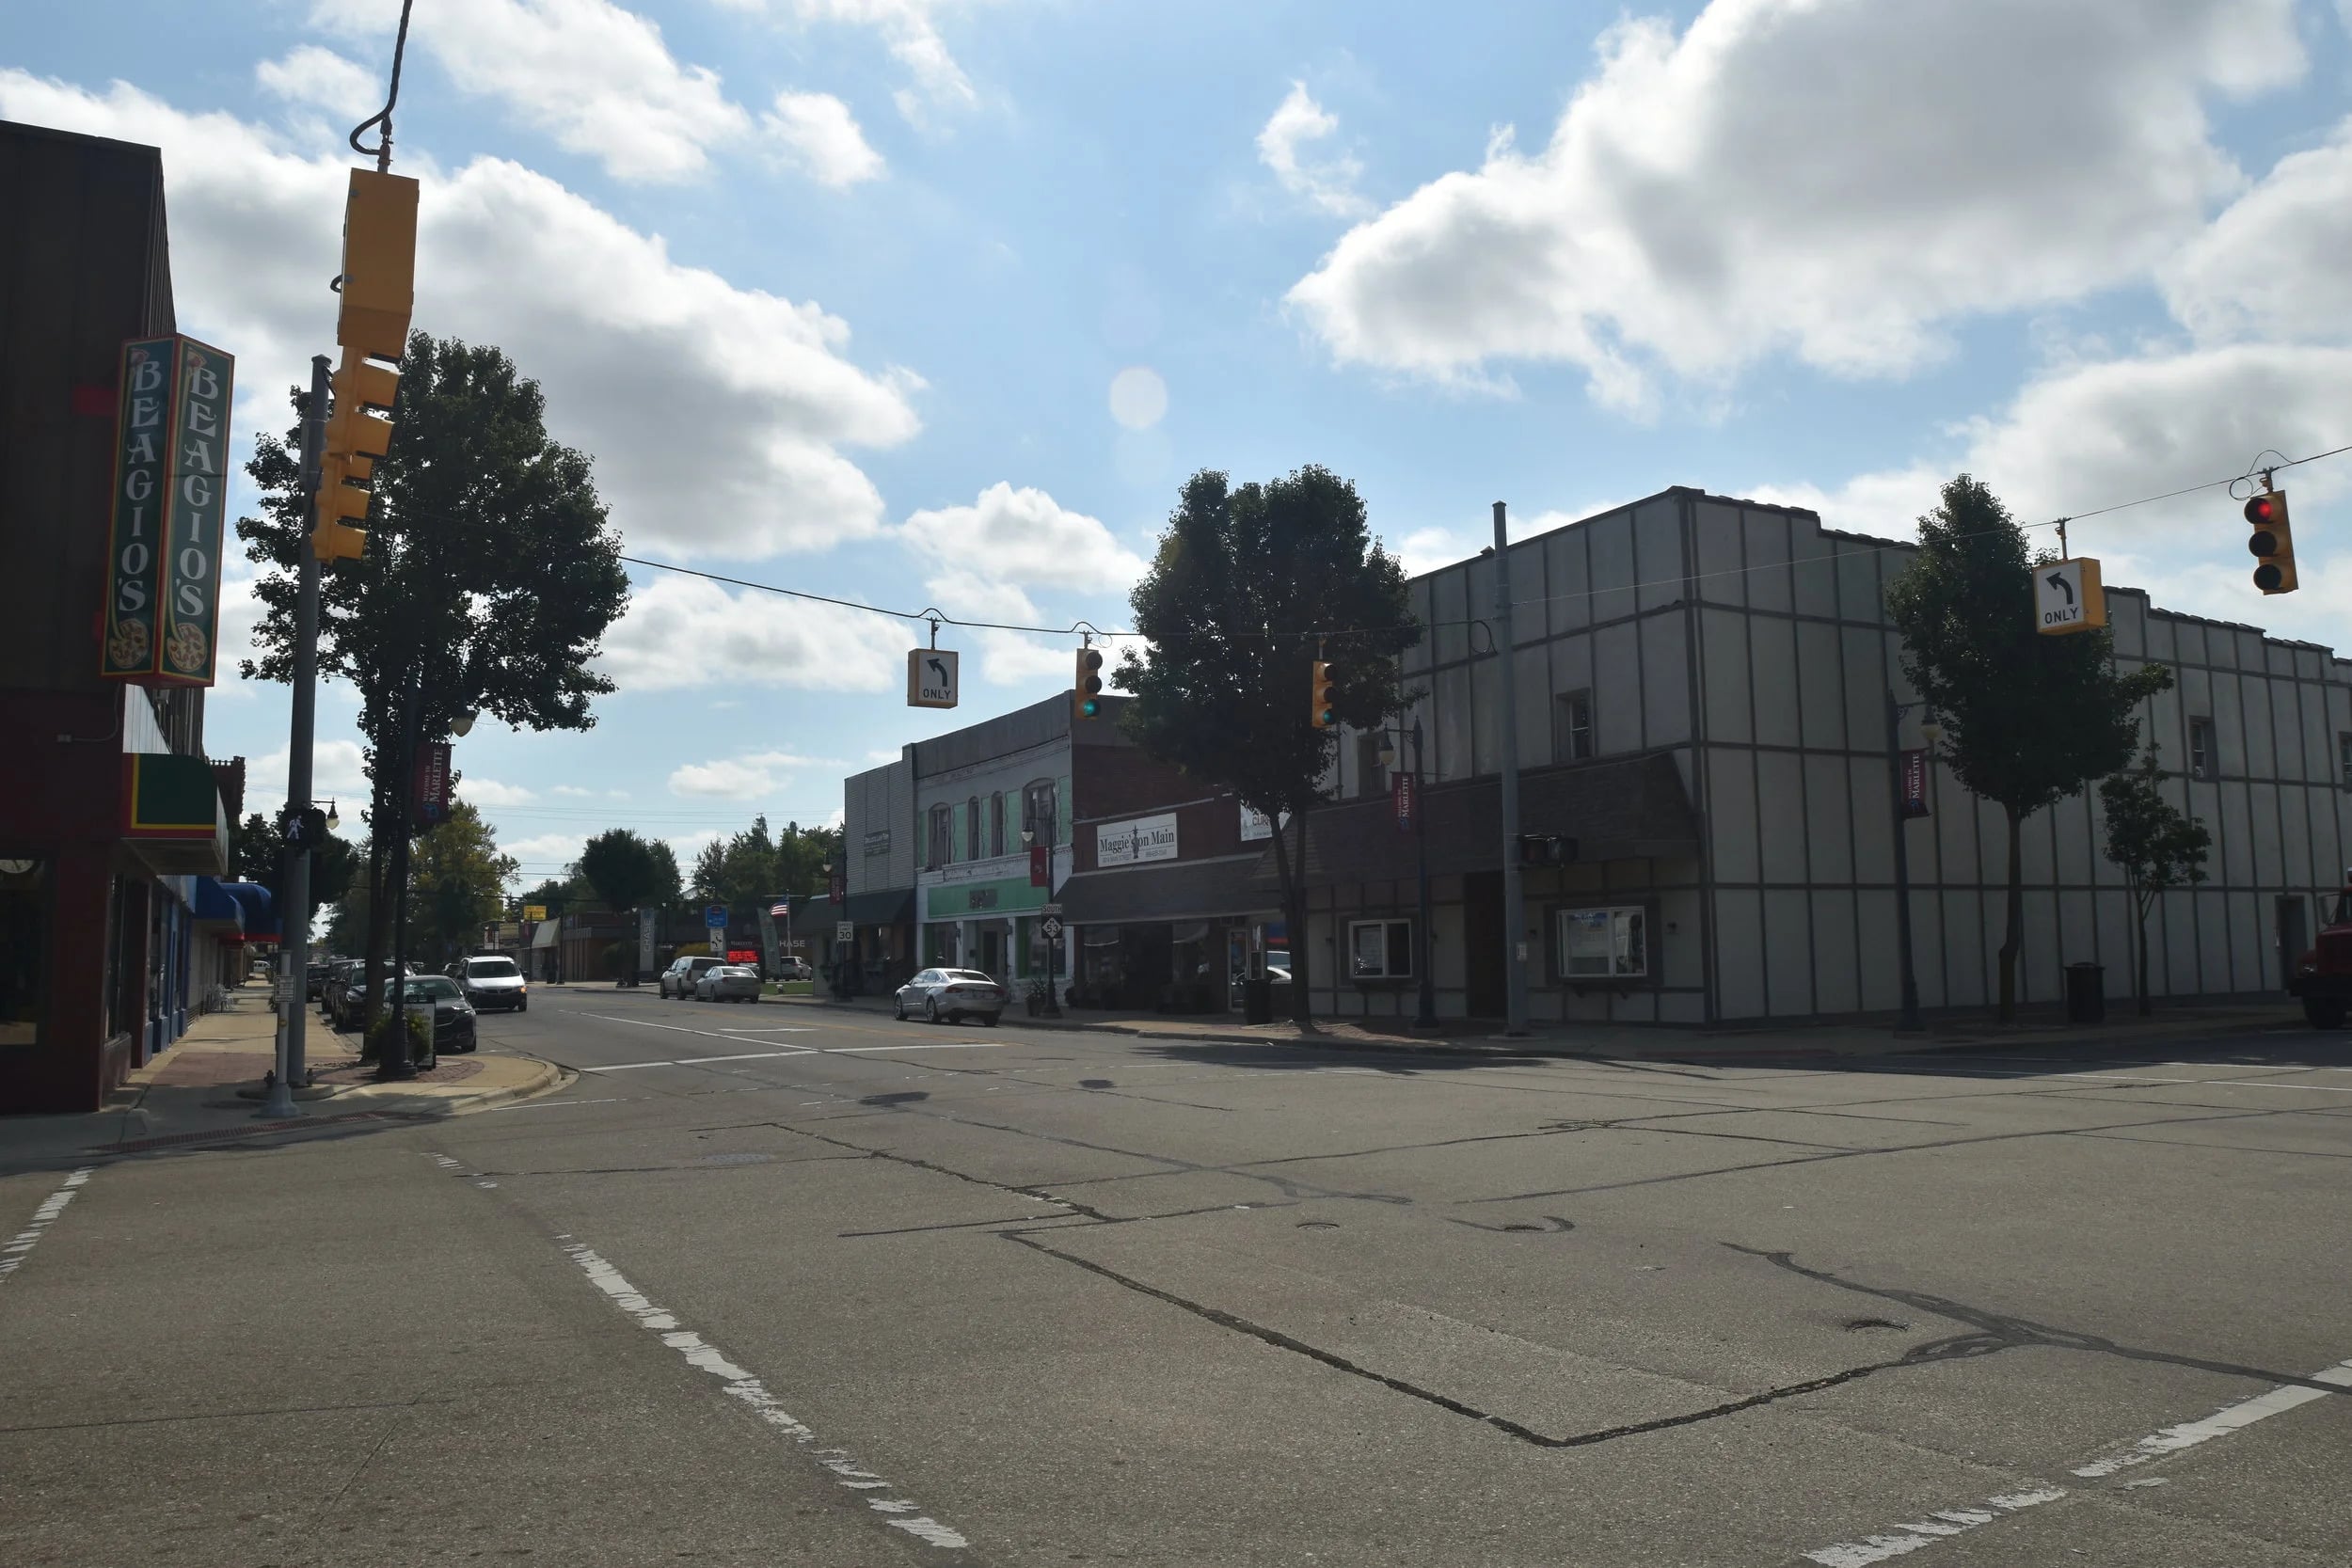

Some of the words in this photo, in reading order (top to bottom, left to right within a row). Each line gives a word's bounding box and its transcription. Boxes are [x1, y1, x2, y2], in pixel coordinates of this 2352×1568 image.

[119, 360, 162, 612] BEAGIO'S
[176, 368, 219, 616] BEAGIO'S
[2044, 607, 2078, 625] ONLY
[923, 688, 951, 700] ONLY
[429, 748, 444, 803] MARLETTE
[1138, 834, 1150, 847] on
[1151, 828, 1175, 846] Main
[643, 919, 651, 953] CHASE
[839, 931, 851, 940] 30
[1046, 925, 1058, 933] 53
[779, 940, 805, 948] HASE
